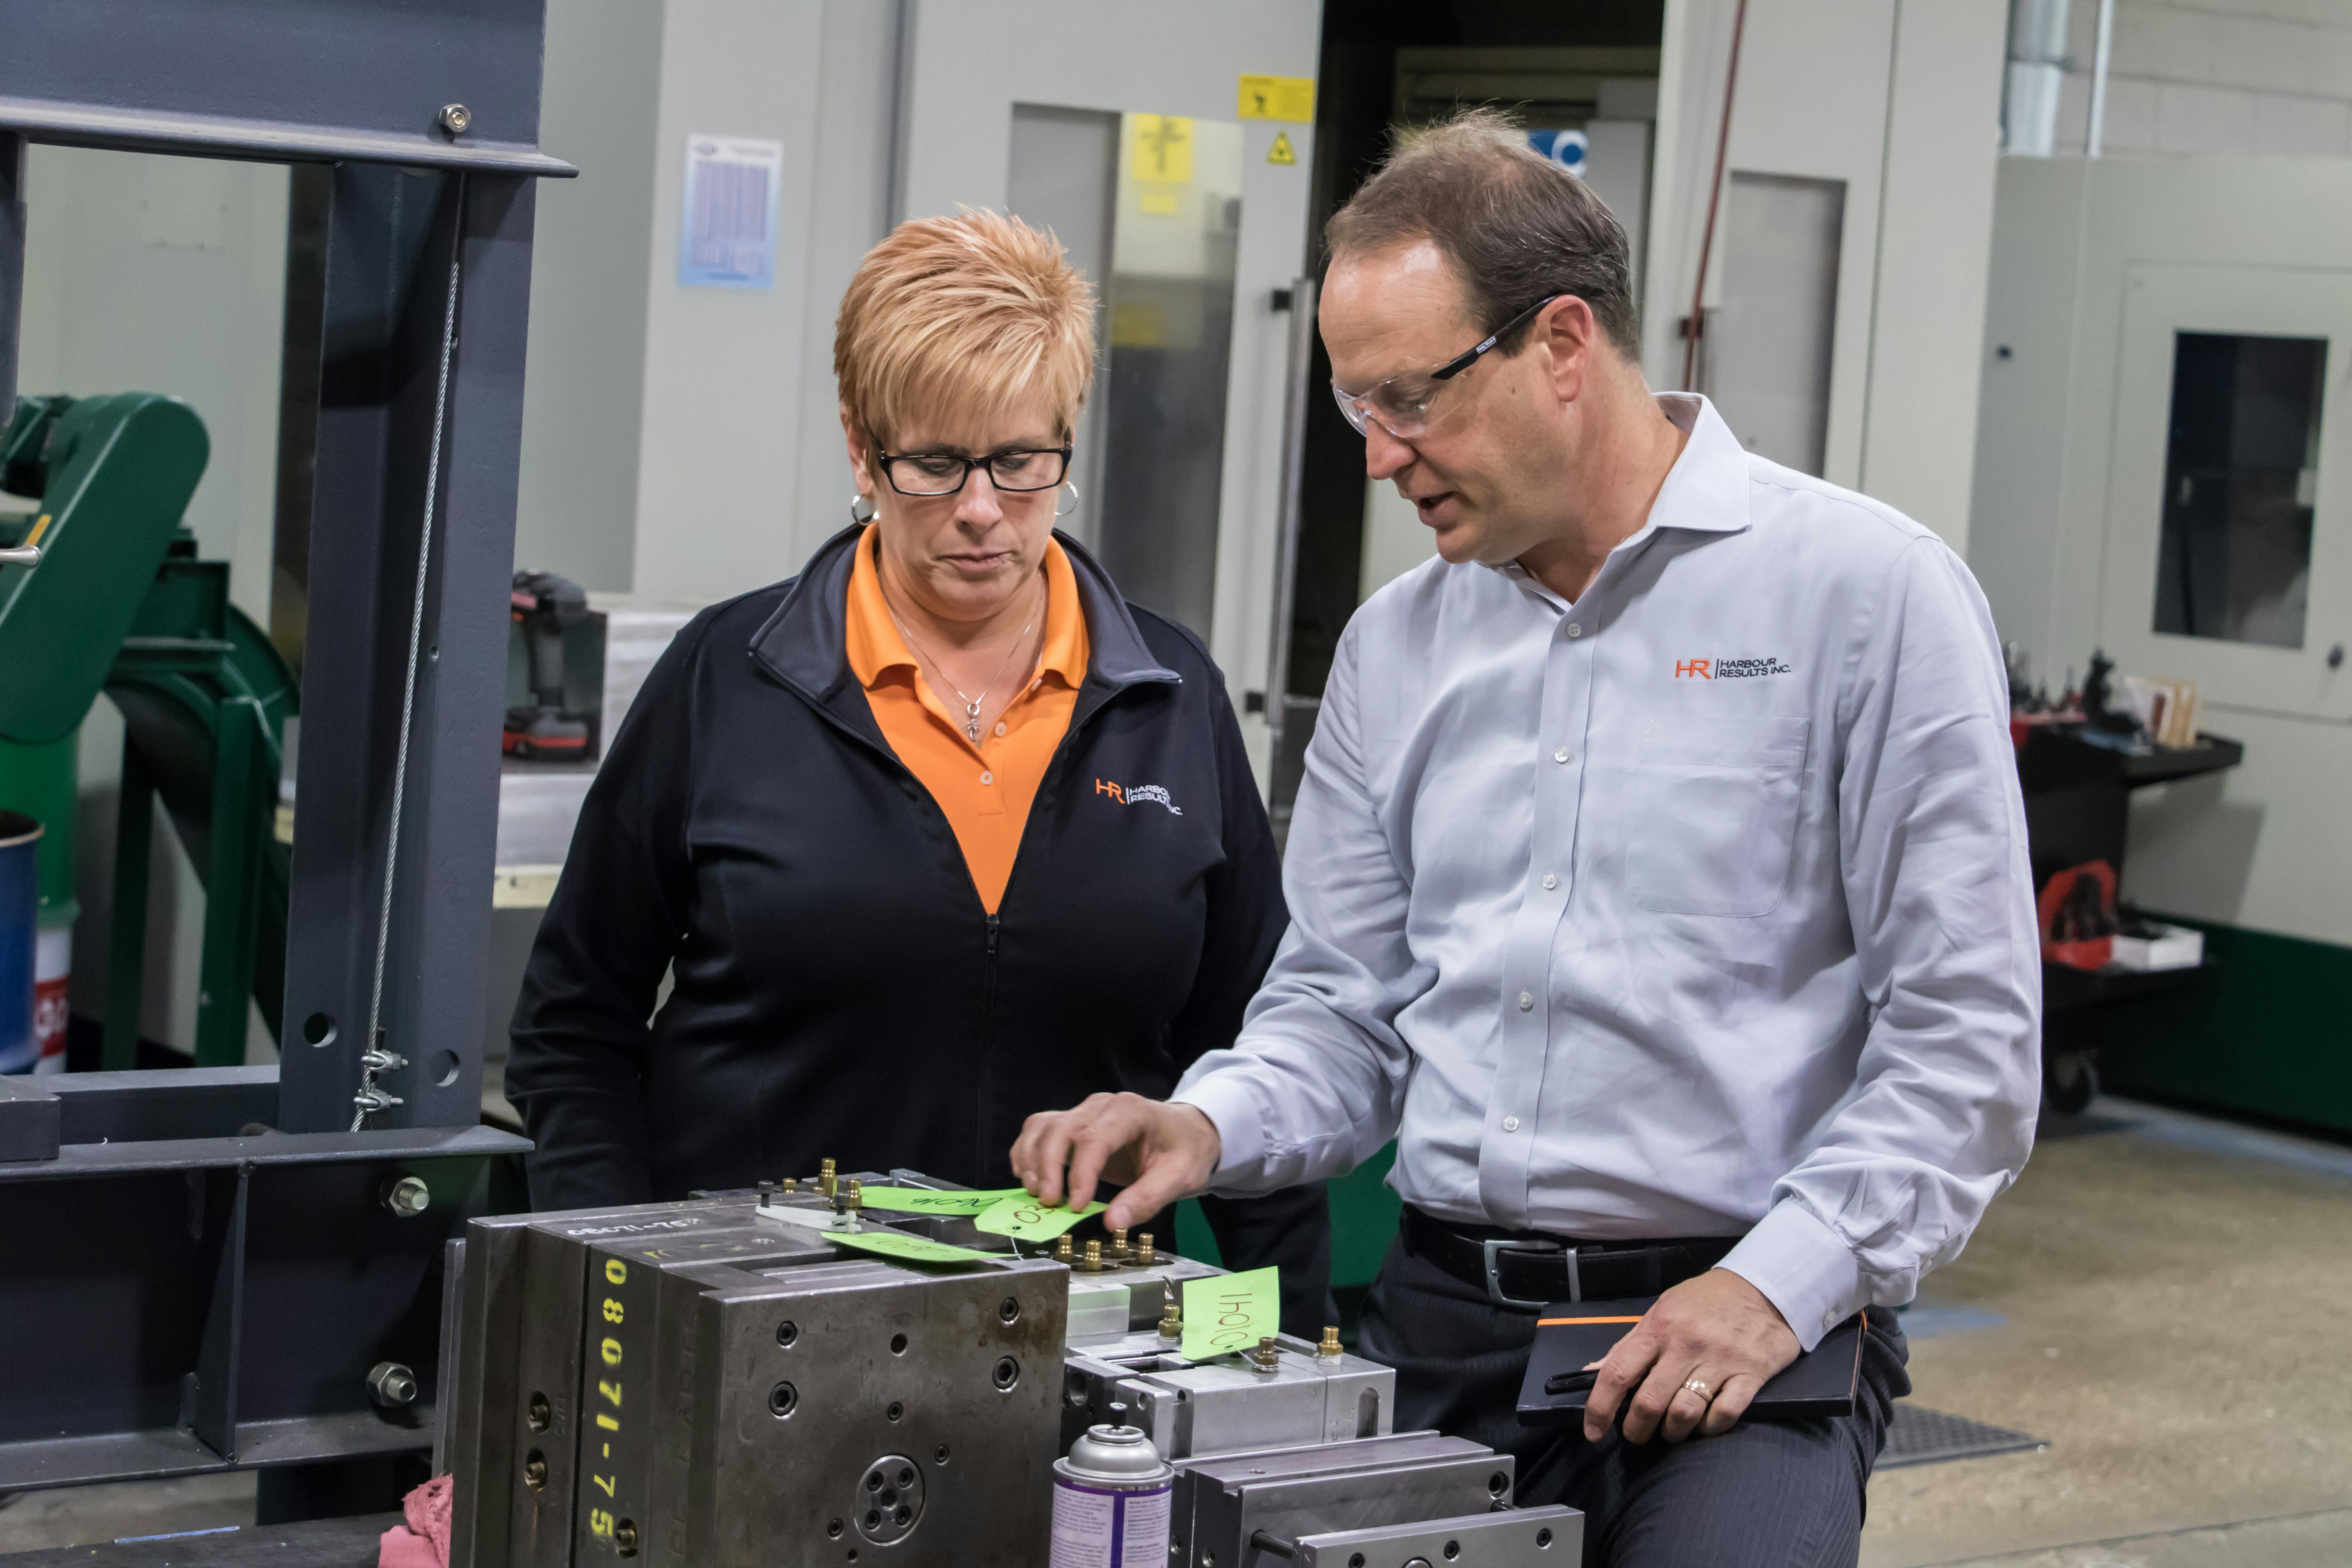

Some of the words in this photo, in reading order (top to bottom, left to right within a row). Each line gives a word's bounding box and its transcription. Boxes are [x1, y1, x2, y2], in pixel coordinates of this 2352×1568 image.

[1675, 658, 1712, 680] HR
[1719, 667, 1768, 677] RESULTS
[1770, 665, 1791, 674] INC.
[1720, 658, 1776, 668] HARBOUR
[1096, 778, 1126, 804] HR
[591, 1259, 627, 1537] 08071-75
